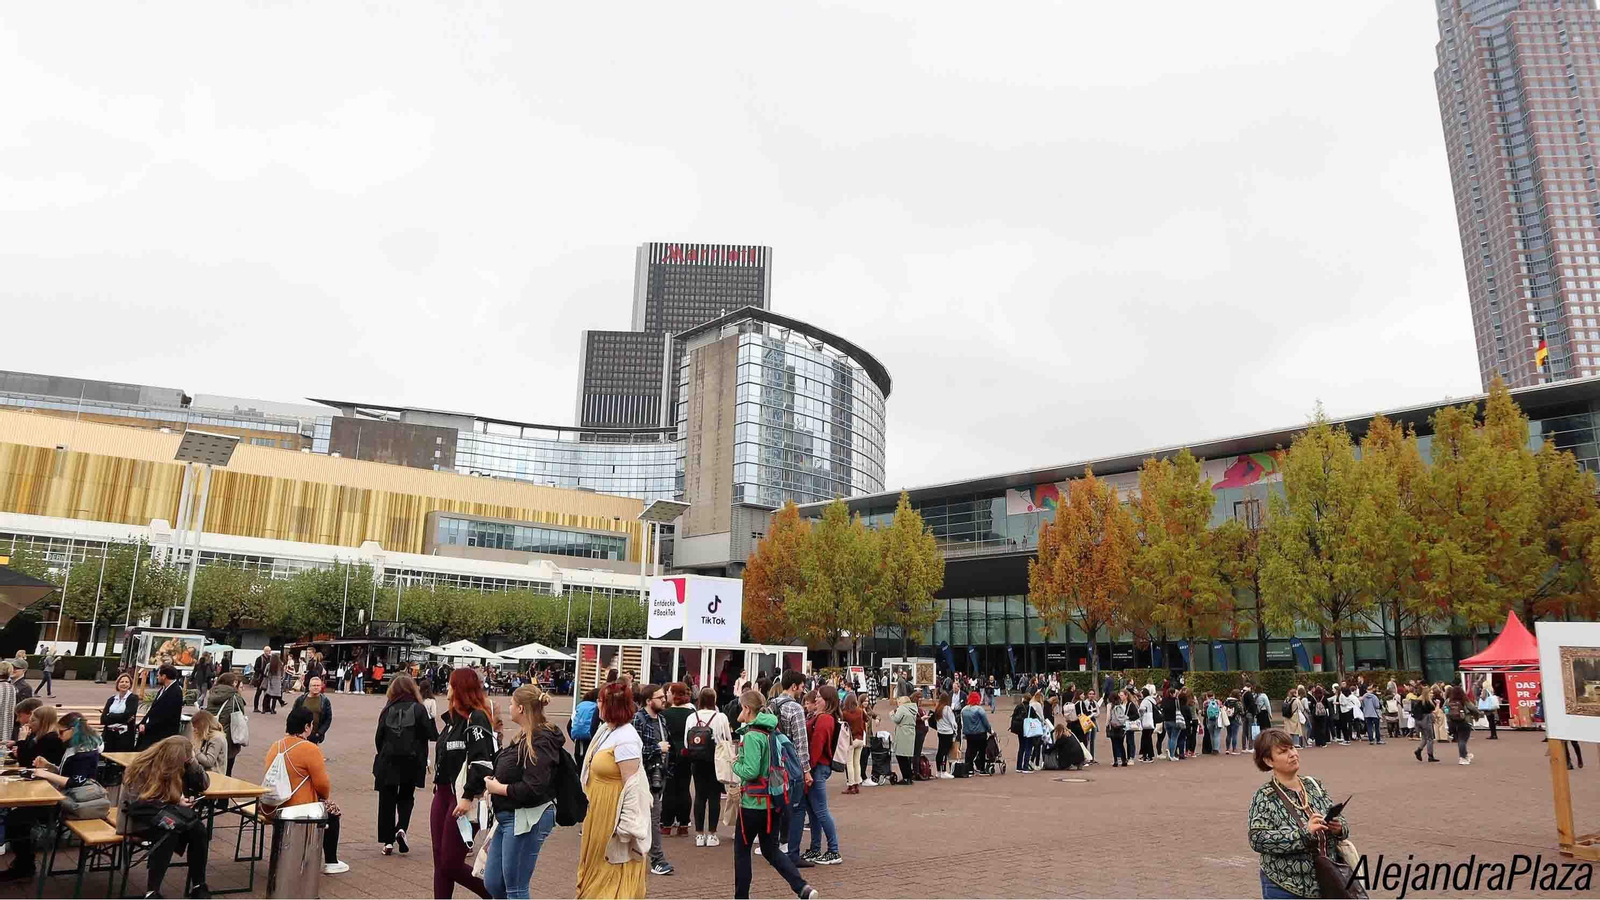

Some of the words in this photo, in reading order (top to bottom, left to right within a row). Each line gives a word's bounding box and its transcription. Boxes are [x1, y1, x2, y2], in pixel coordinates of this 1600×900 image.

[654, 599, 675, 607] Entdecke
[653, 608, 676, 616] #BookTok
[701, 616, 726, 625] TikTok
[1515, 681, 1536, 689] DAS
